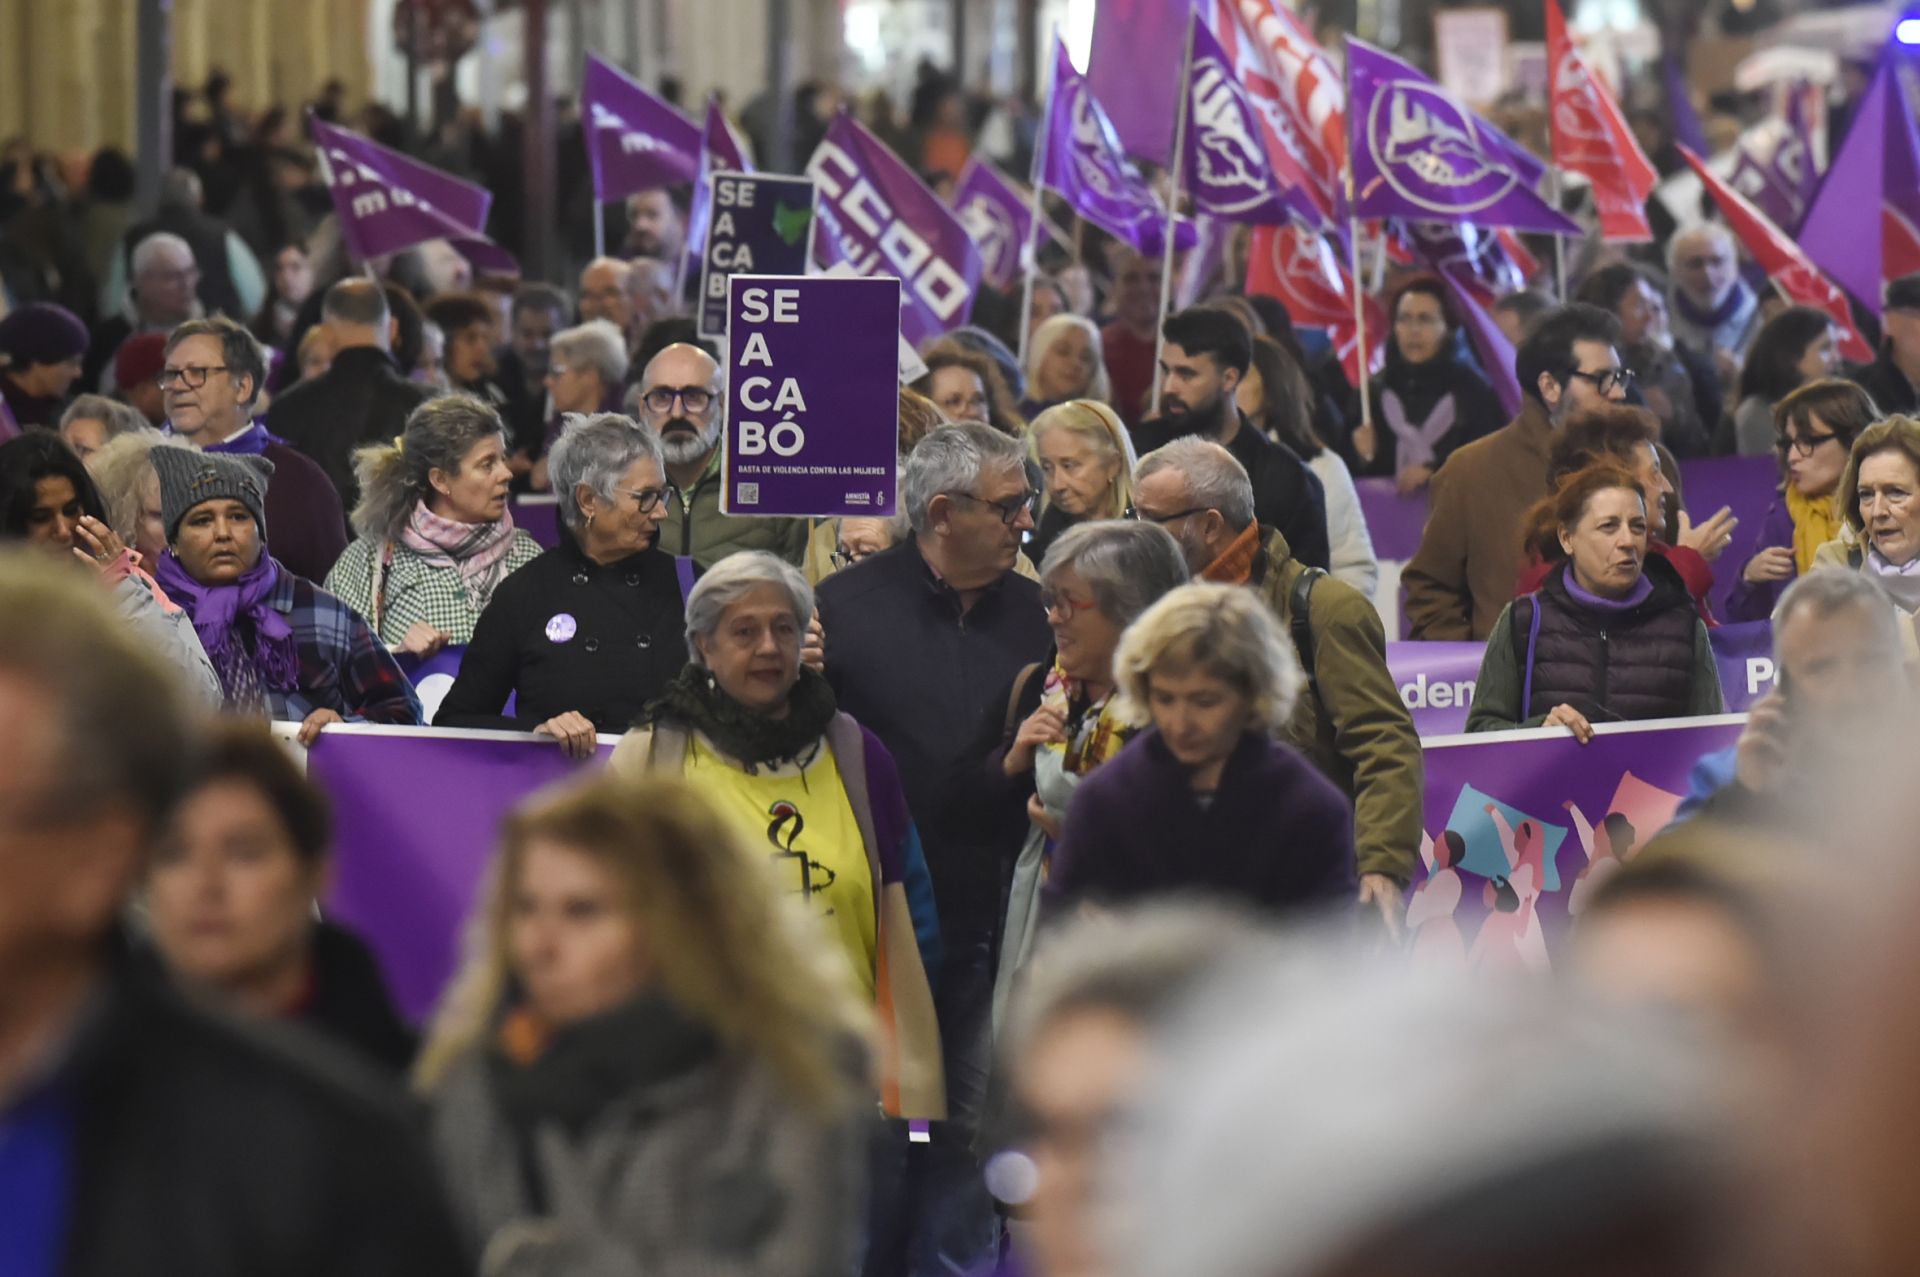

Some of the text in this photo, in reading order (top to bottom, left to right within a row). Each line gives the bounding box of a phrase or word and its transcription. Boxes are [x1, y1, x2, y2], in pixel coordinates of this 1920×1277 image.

[717, 180, 756, 207] SE
[714, 211, 735, 238] A
[806, 139, 971, 321] CCOO
[711, 241, 753, 270] CA
[740, 287, 800, 323] SE
[739, 332, 773, 367] A
[739, 376, 807, 412] CA
[738, 411, 805, 457] BÓ
[738, 465, 885, 475] BASTA DE VIOLENCIA CONTRA LAS MUJERES
